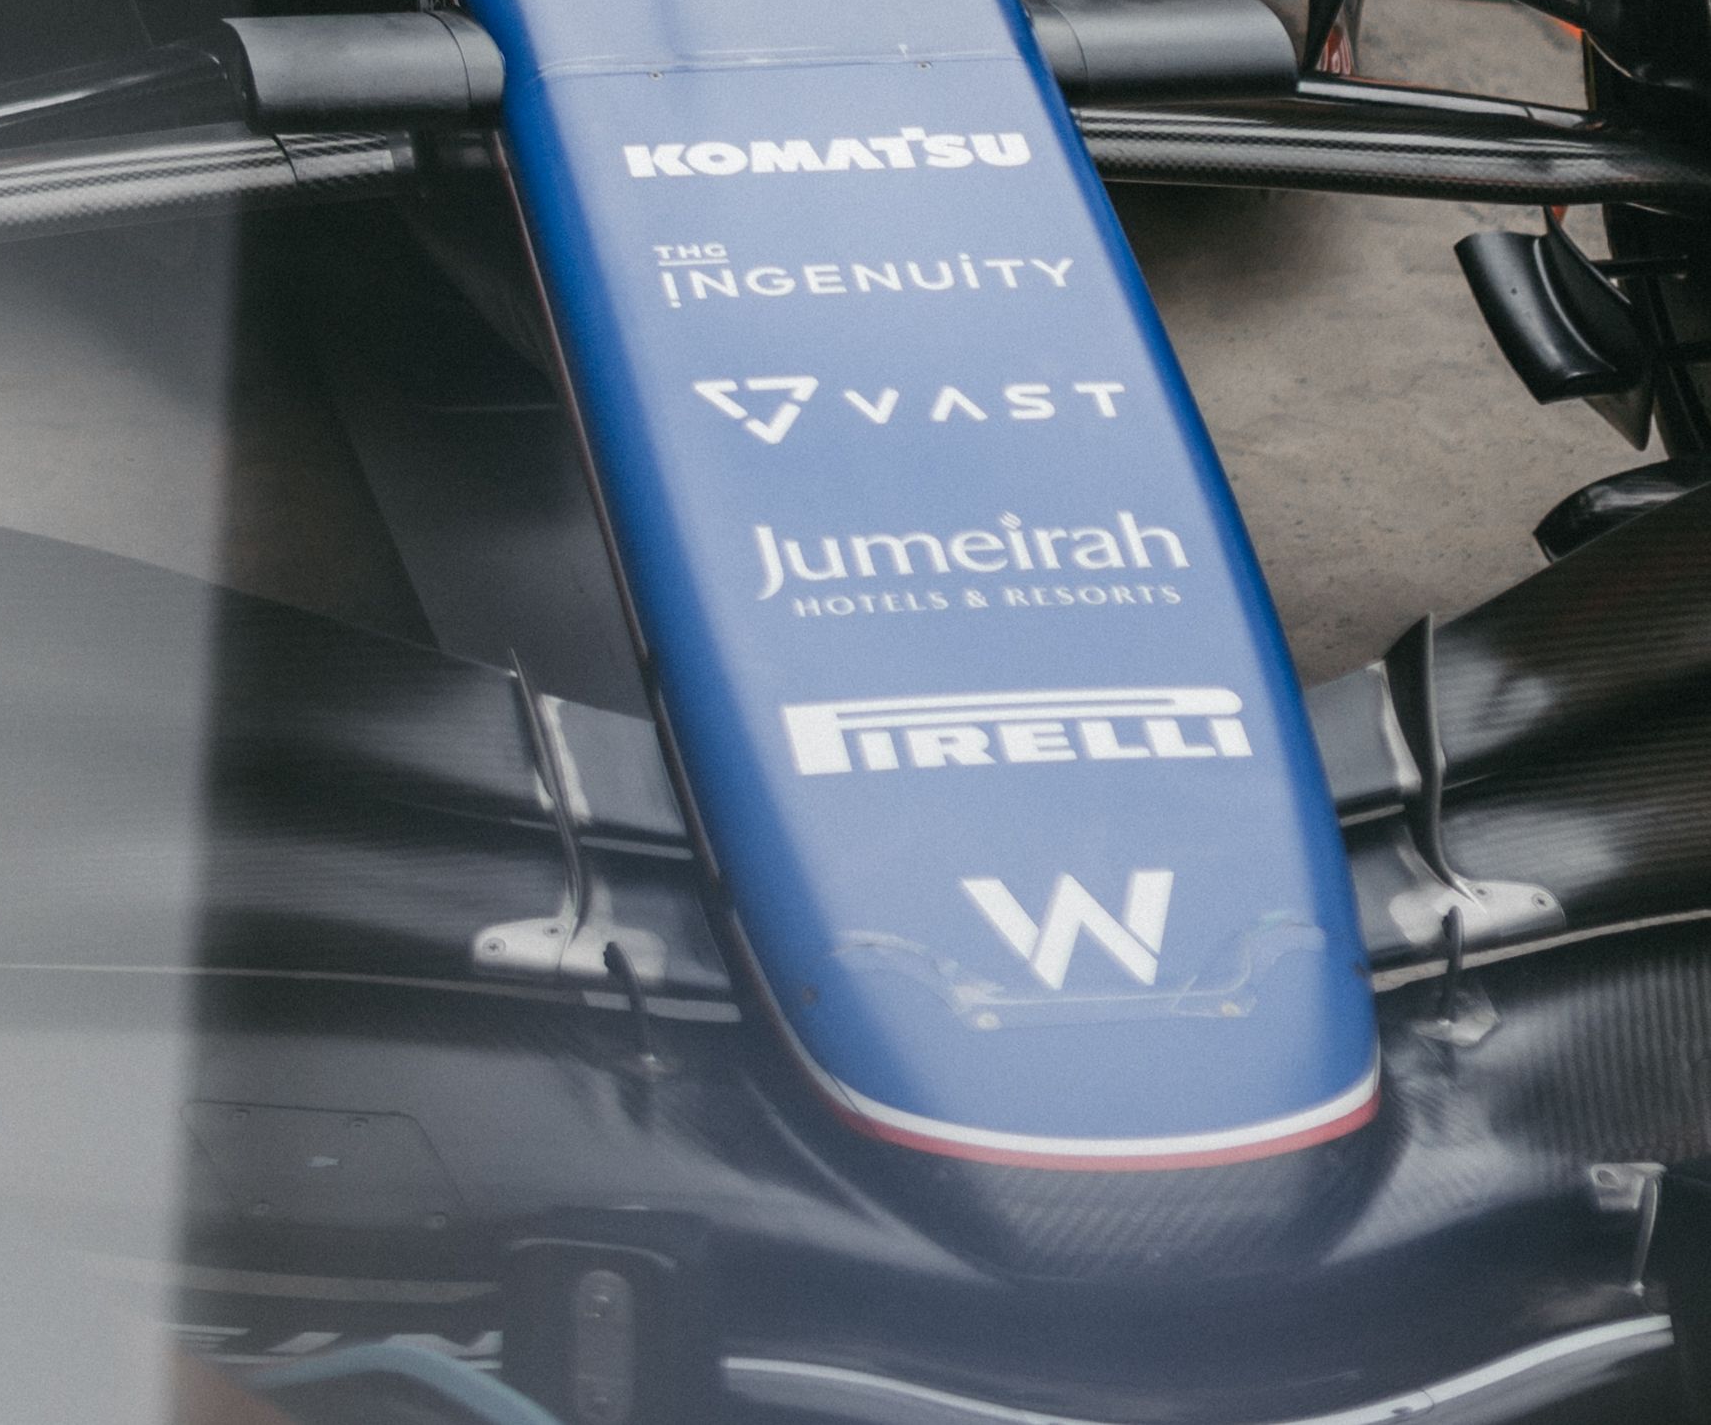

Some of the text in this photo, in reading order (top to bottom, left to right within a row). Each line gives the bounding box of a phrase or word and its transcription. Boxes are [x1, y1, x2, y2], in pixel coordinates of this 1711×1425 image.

[625, 126, 1032, 178] KOMATSU
[653, 242, 728, 261] THG
[842, 381, 1126, 425] VAST
[754, 510, 1191, 601] Jumeirah
[793, 584, 1183, 618] HOTELS & RESORTS
[781, 688, 1255, 777] PIRELLI
[959, 870, 1176, 992] W
